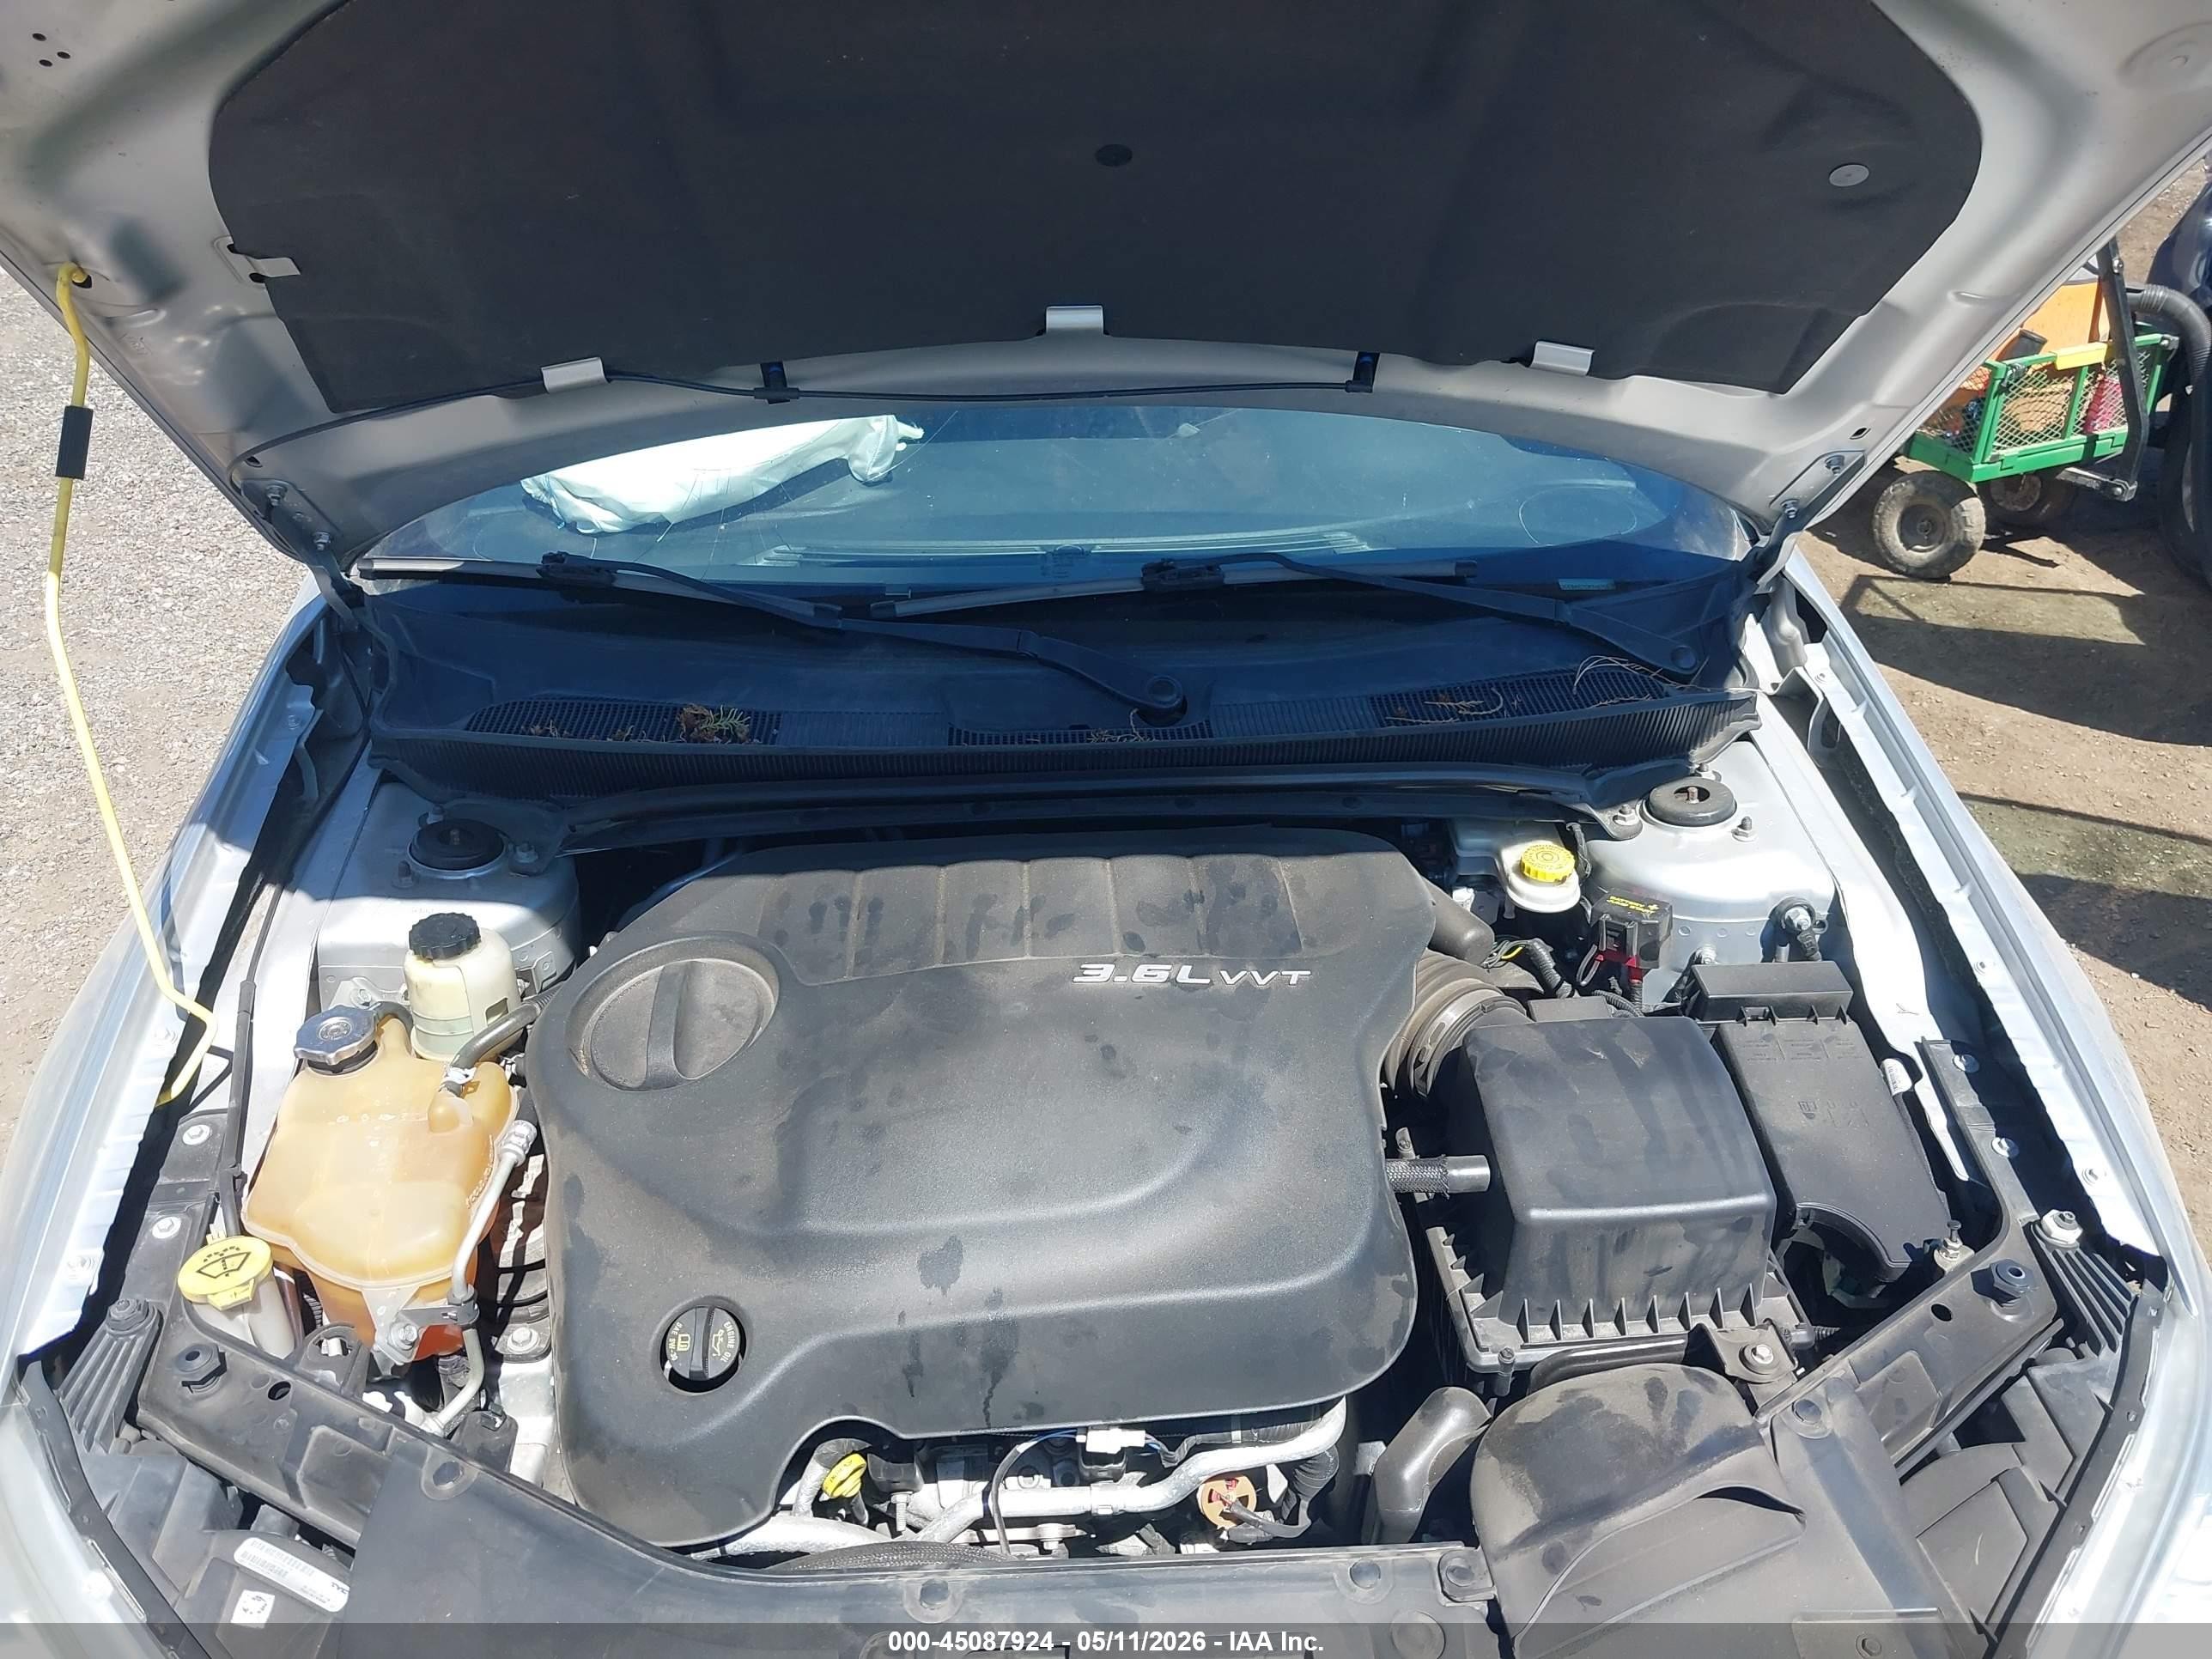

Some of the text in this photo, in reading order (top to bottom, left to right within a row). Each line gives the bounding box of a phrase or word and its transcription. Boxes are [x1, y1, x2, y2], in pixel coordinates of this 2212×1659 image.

[1073, 963, 1311, 986] 3.6L VVT
[720, 1321, 736, 1363] ENGINE OIL
